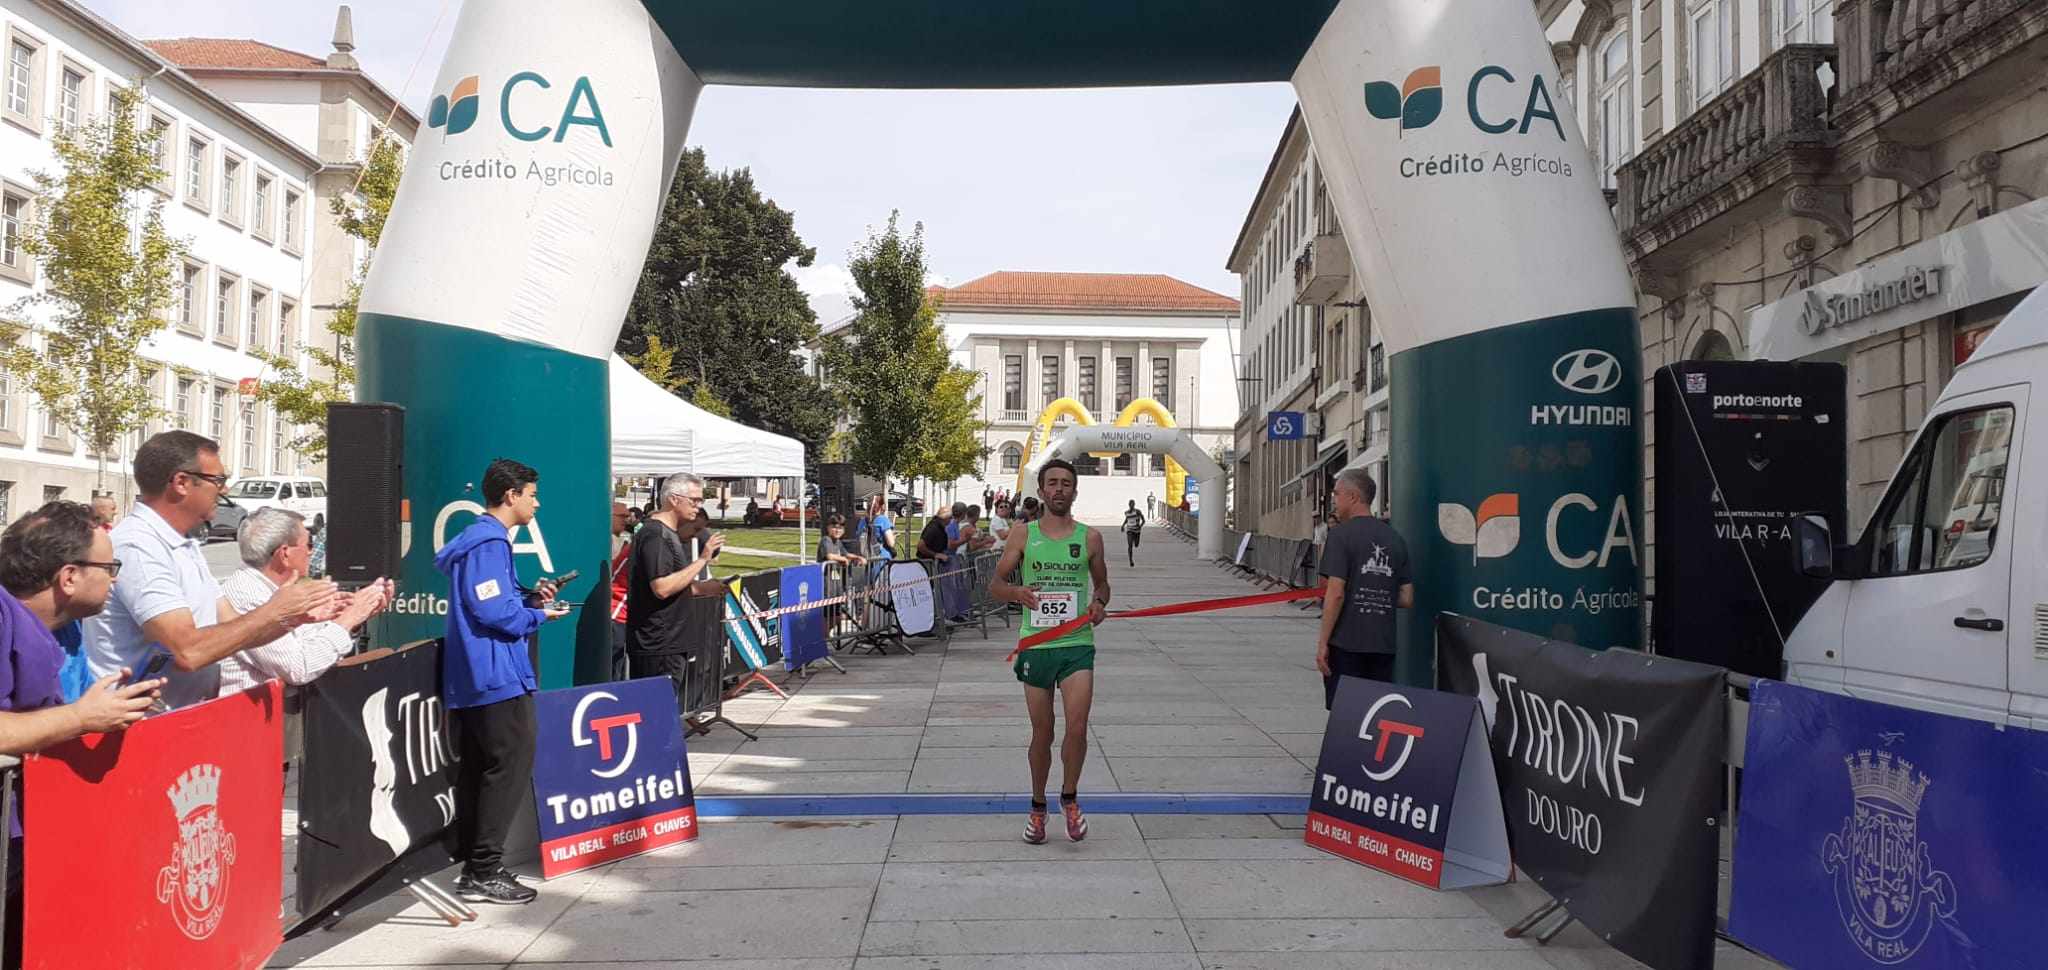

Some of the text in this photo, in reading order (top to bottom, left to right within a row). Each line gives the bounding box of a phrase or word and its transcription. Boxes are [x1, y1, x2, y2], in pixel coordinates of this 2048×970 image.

[501, 71, 614, 149] CA
[1467, 65, 1566, 141] CA
[440, 159, 614, 187] Crédito Agrícola
[1400, 152, 1572, 178] Crédito Agrícola
[1823, 267, 1942, 328] Santander
[1531, 405, 1631, 426] HYUNDAI
[1713, 394, 1802, 409] portoenorte
[1100, 431, 1152, 441] MUNICÍPIO
[1546, 492, 1638, 569] CA
[1715, 524, 1752, 539] VILA
[384, 592, 448, 615] rédito
[1041, 602, 1068, 615] 652
[1473, 585, 1639, 614] Crédito Agrícola
[1497, 672, 1645, 807] TIRONE
[547, 769, 685, 825] Tomeifel
[1322, 773, 1440, 833] Tomeifel
[551, 815, 691, 862] VILA REAL RÉGUA CHAVES
[1526, 787, 1602, 855] DOURO
[1312, 819, 1433, 872] VILA REAL RÉGUA CHAVES
[1850, 913, 1909, 958] VILA REAL
